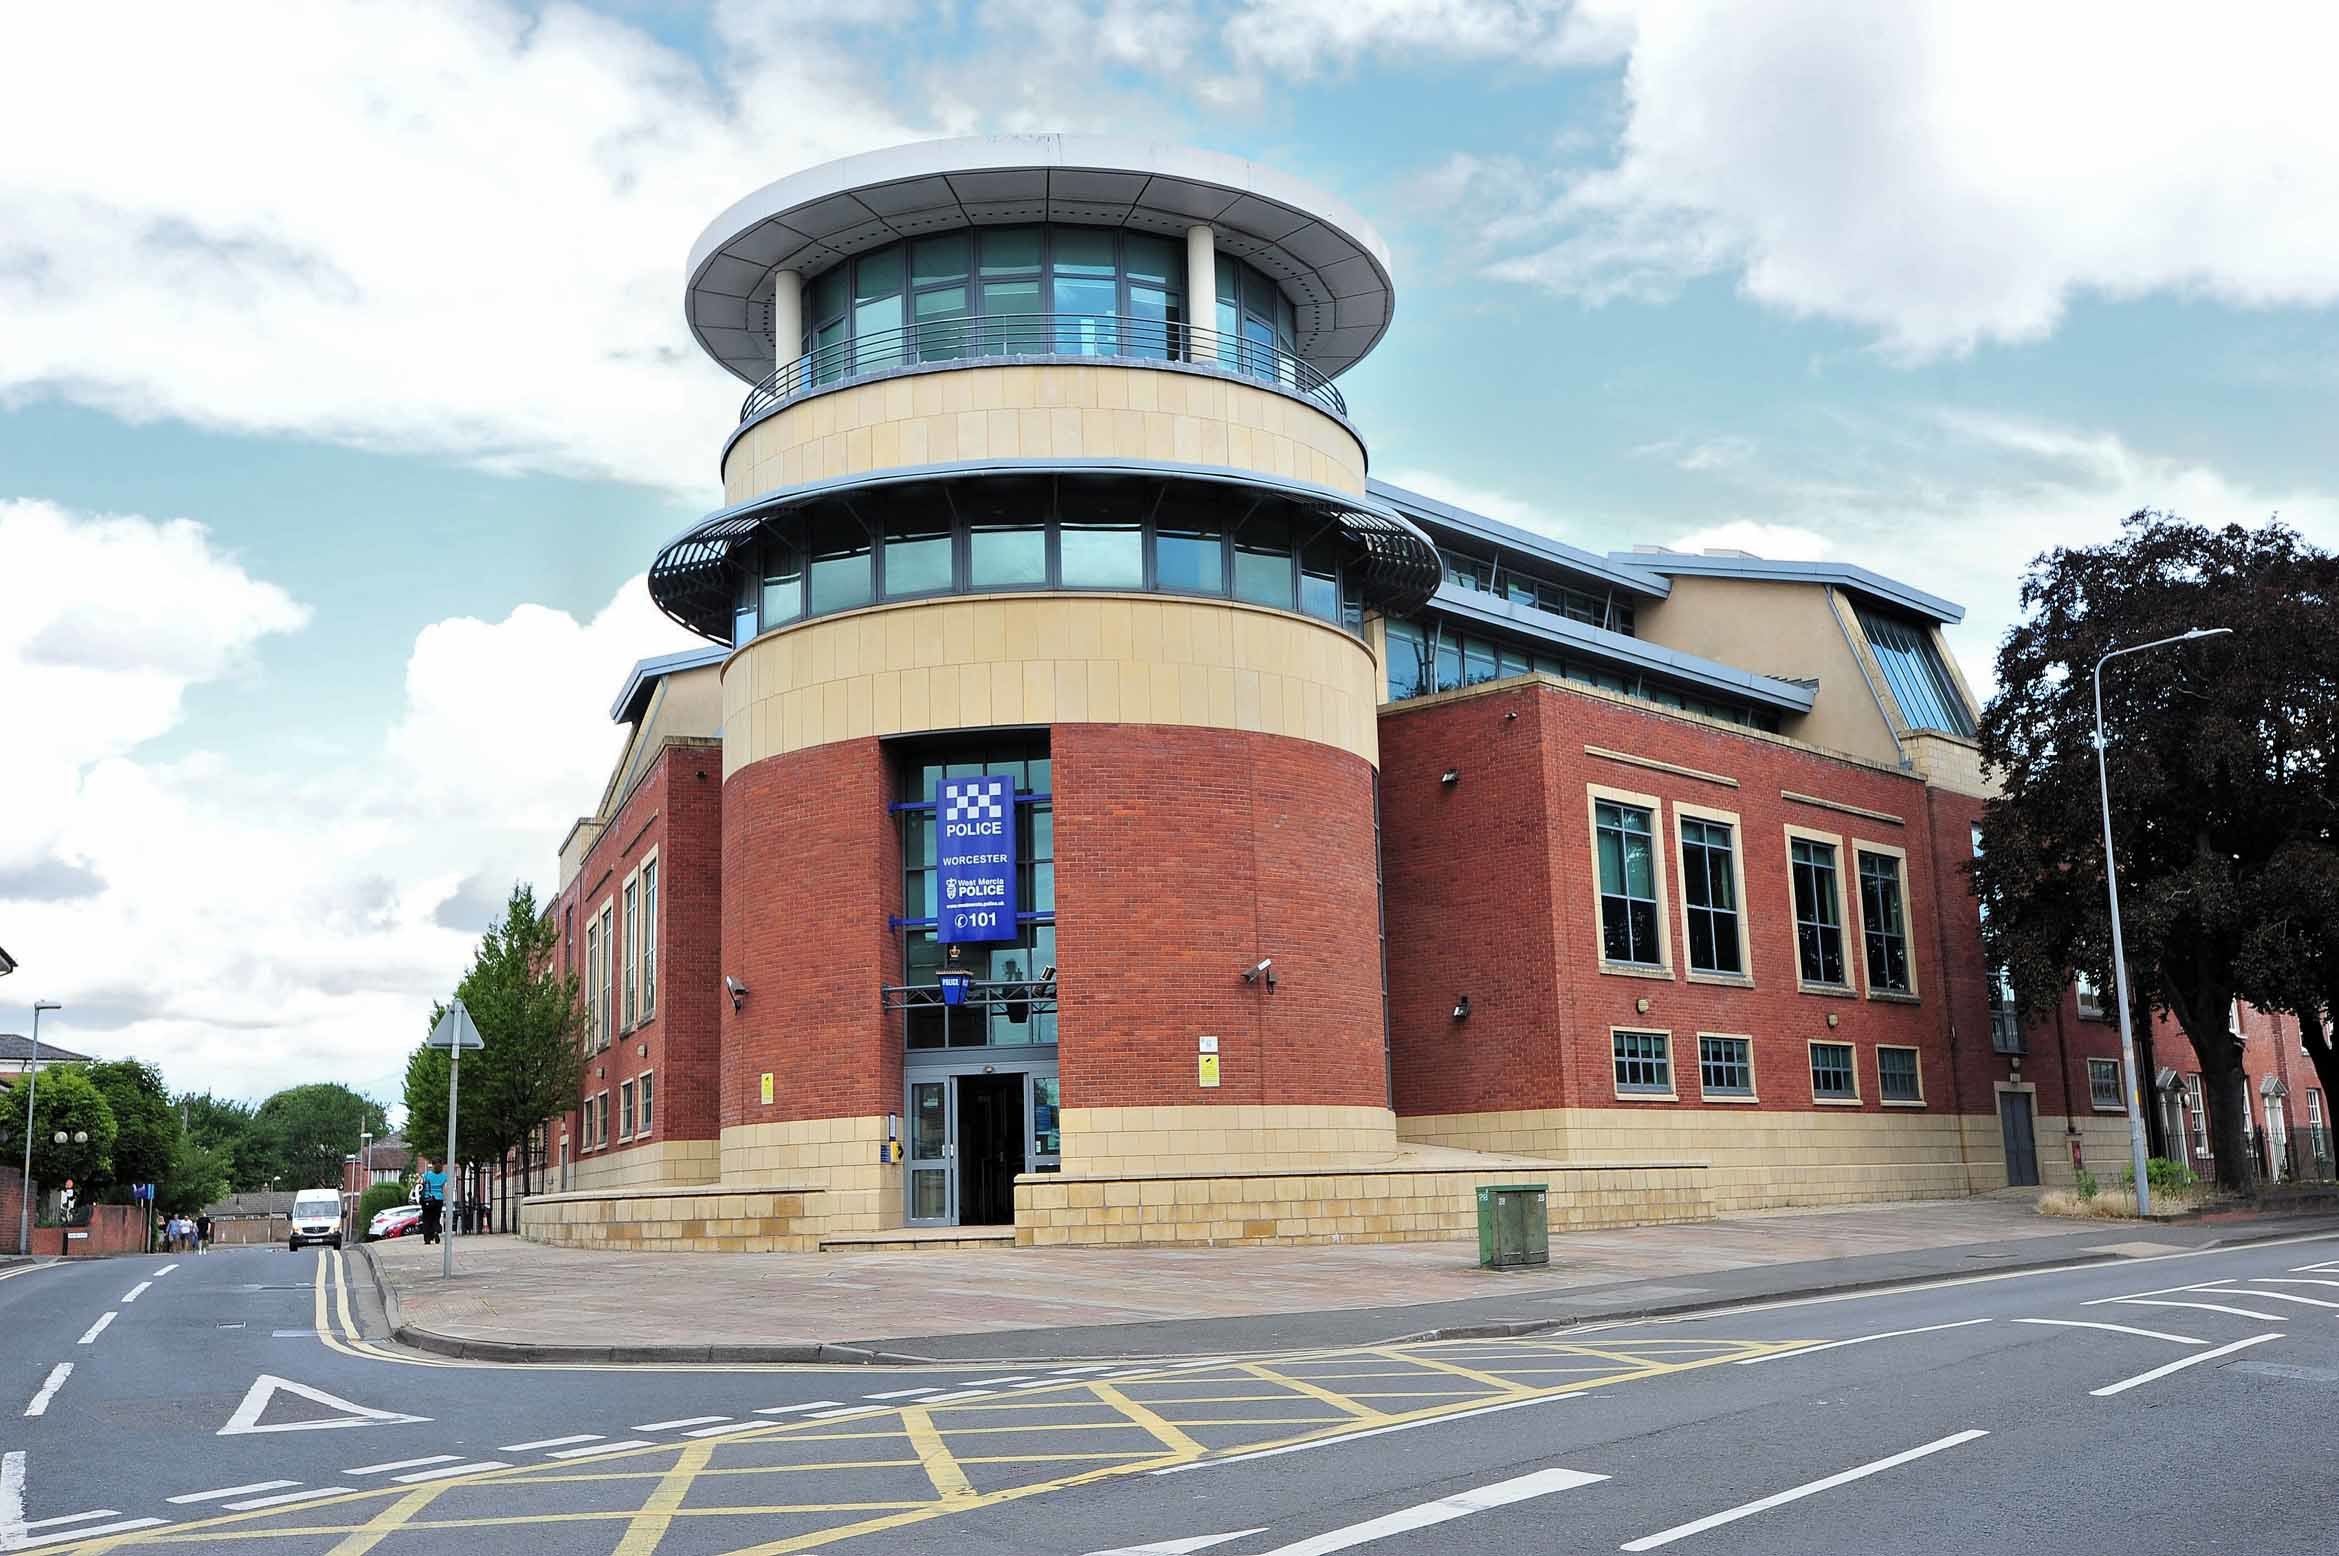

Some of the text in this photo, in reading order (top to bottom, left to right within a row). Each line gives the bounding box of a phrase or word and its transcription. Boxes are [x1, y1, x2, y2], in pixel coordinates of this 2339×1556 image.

[946, 821, 1002, 838] POLICE
[942, 854, 1008, 867] WORCESTER
[957, 877, 1004, 887] West Mercia
[958, 885, 1005, 897] POLICE
[969, 911, 996, 927] 101
